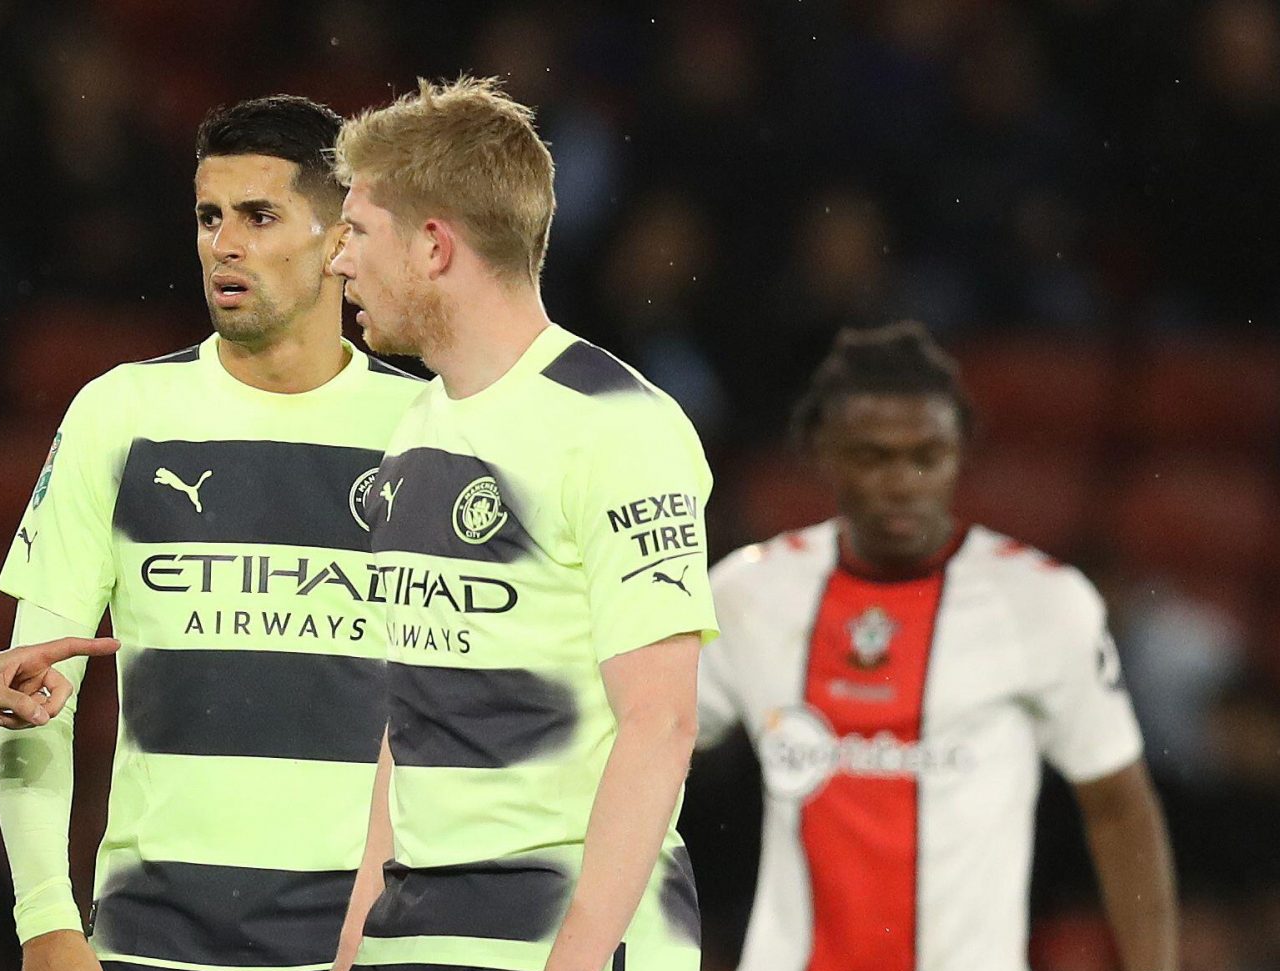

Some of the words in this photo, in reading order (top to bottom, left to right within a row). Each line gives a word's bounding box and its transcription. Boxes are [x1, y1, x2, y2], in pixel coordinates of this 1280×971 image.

[630, 523, 699, 557] TIRE
[378, 566, 519, 614] TIHAD
[184, 610, 367, 642] AIRWAYS
